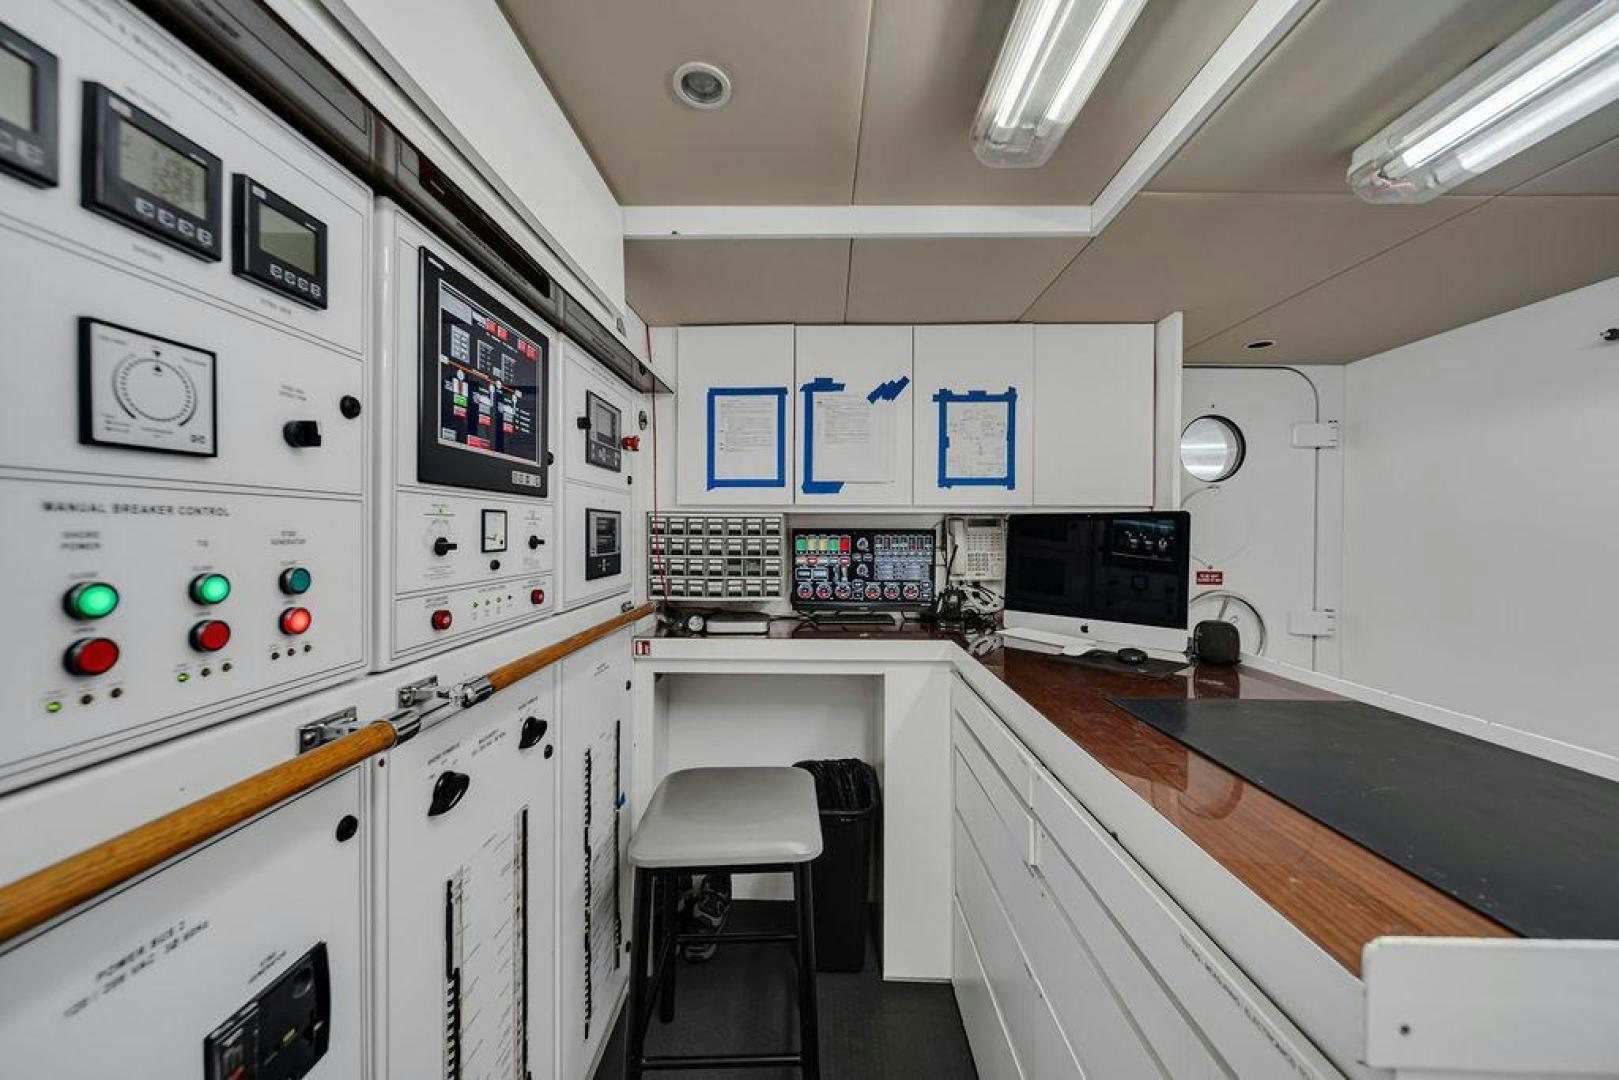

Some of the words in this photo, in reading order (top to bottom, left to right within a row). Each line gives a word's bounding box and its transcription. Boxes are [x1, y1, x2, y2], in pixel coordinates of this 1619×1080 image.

[42, 501, 106, 513] MANUAL
[111, 503, 173, 515] BREAKER
[178, 505, 231, 517] CONTROL
